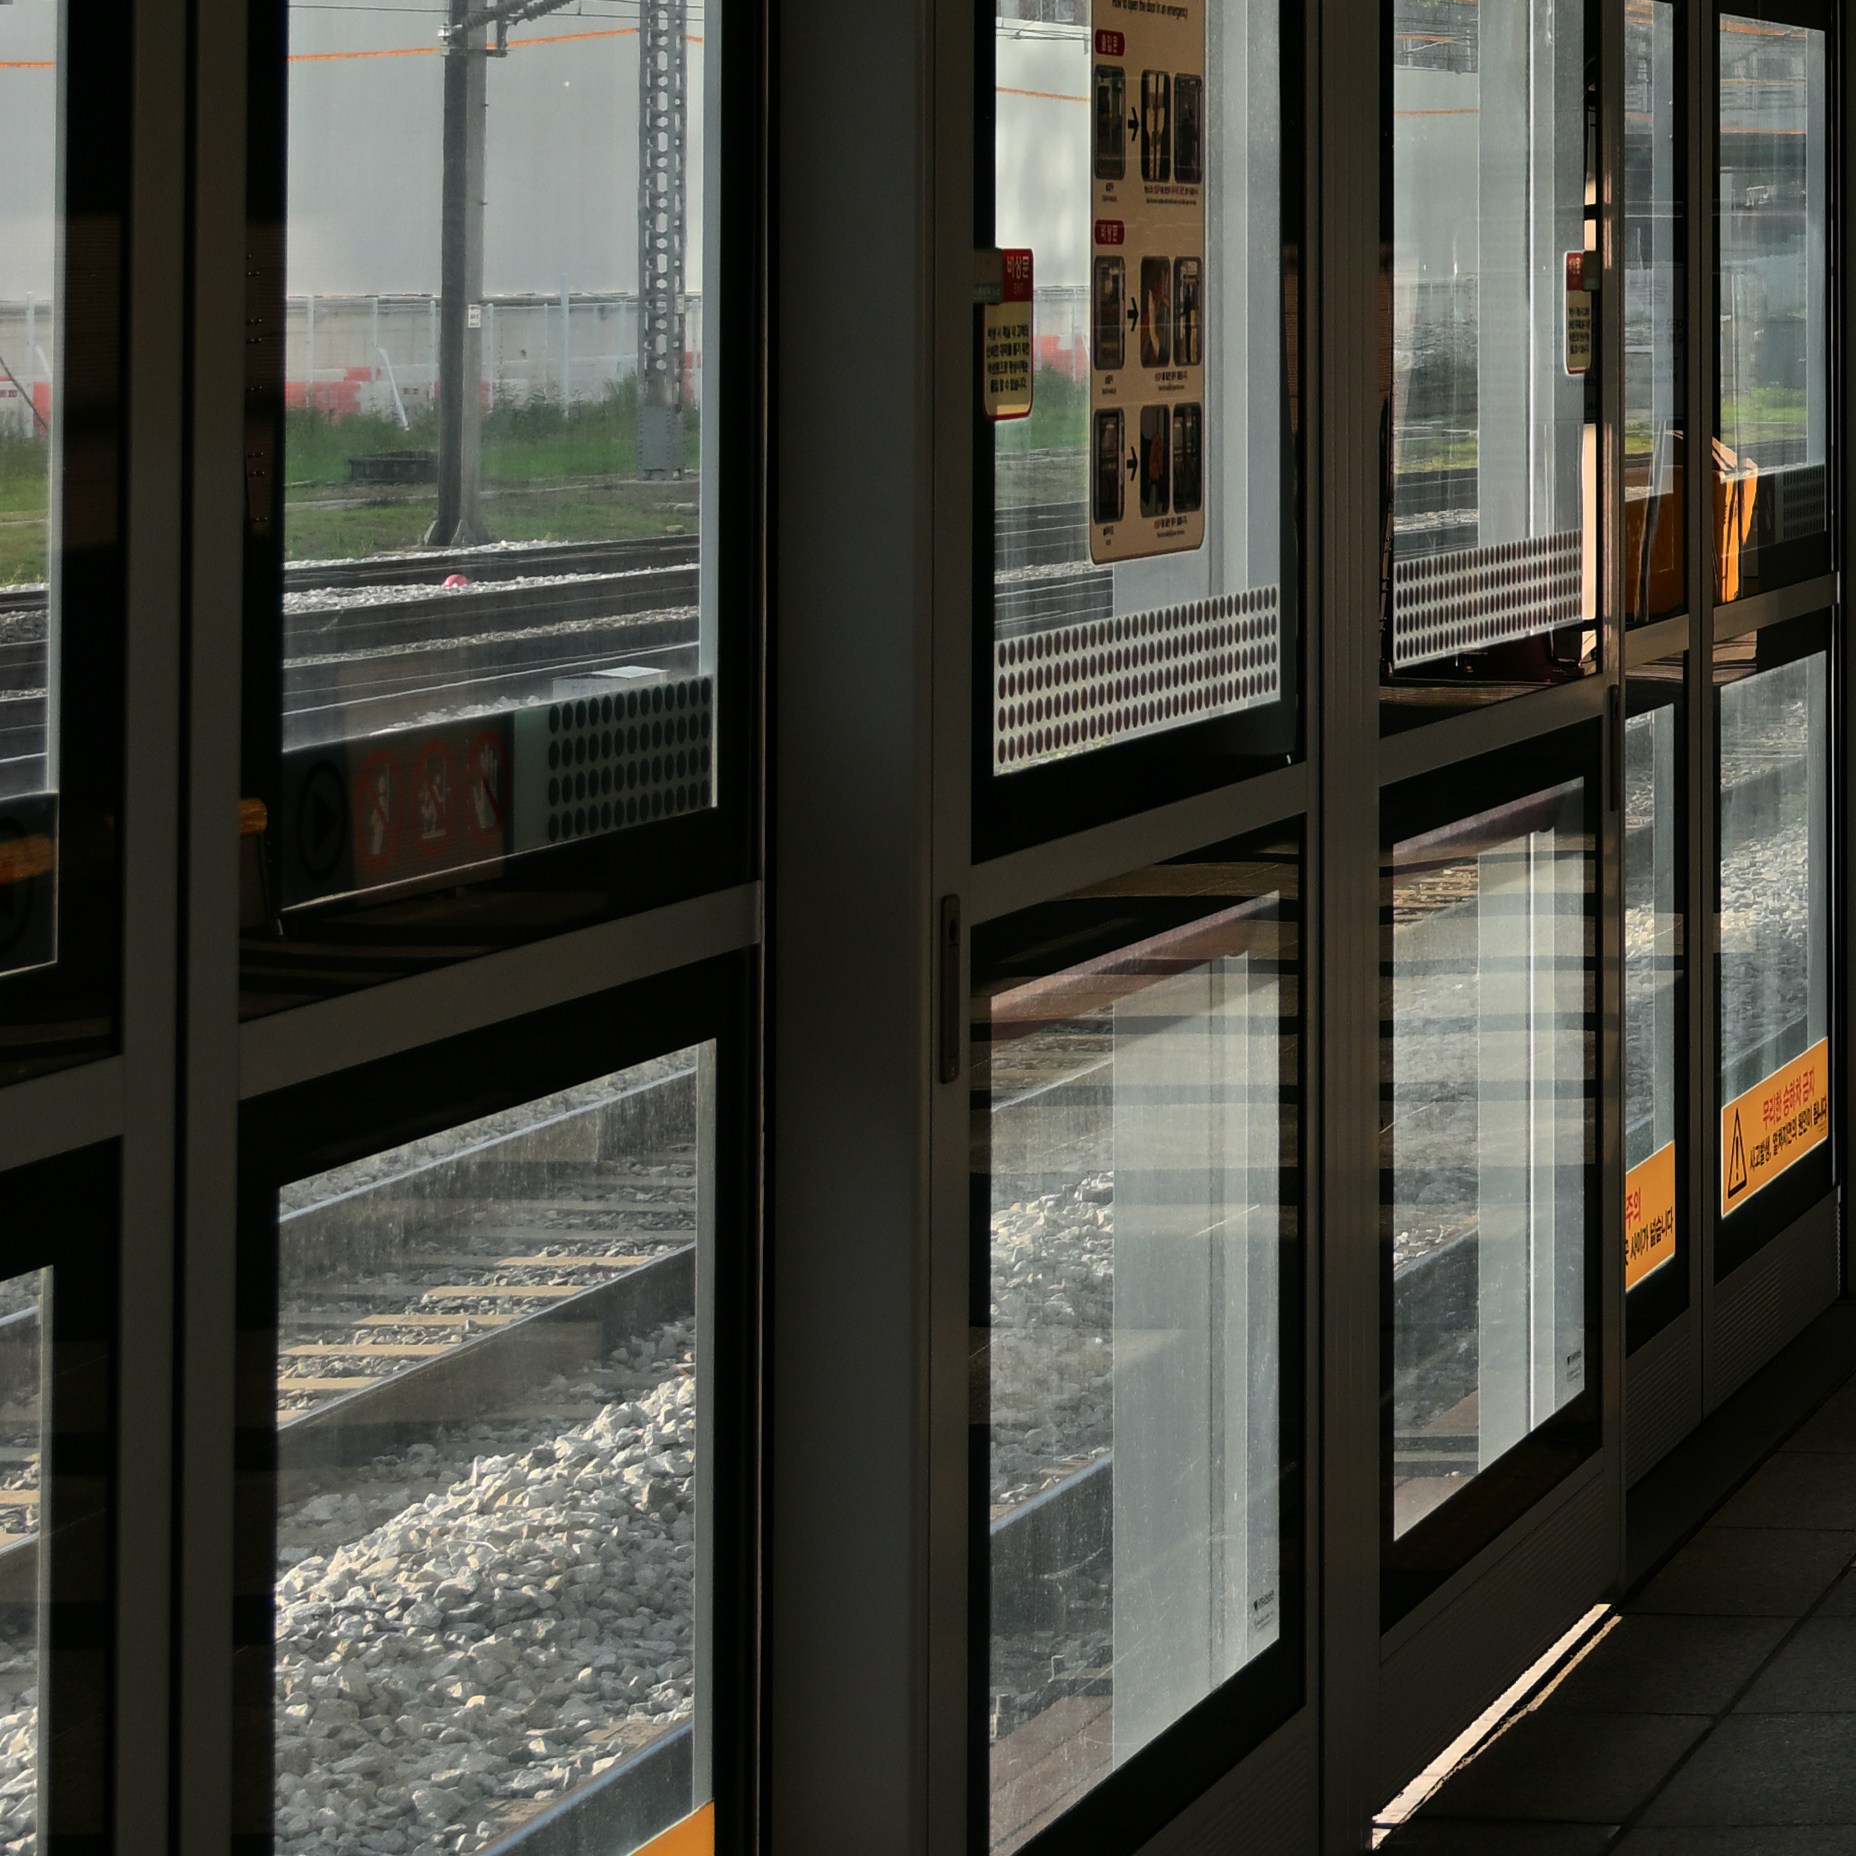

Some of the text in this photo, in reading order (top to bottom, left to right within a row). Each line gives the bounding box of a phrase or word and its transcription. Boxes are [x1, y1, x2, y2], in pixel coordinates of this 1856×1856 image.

[1006, 255, 1030, 280] 비상문
[1763, 1066, 1815, 1131] 무리한 승하차 금지
[1813, 1094, 1828, 1126] 됩니다
[1630, 1223, 1649, 1261] 사이가
[1650, 1205, 1674, 1249] 넓습니다
